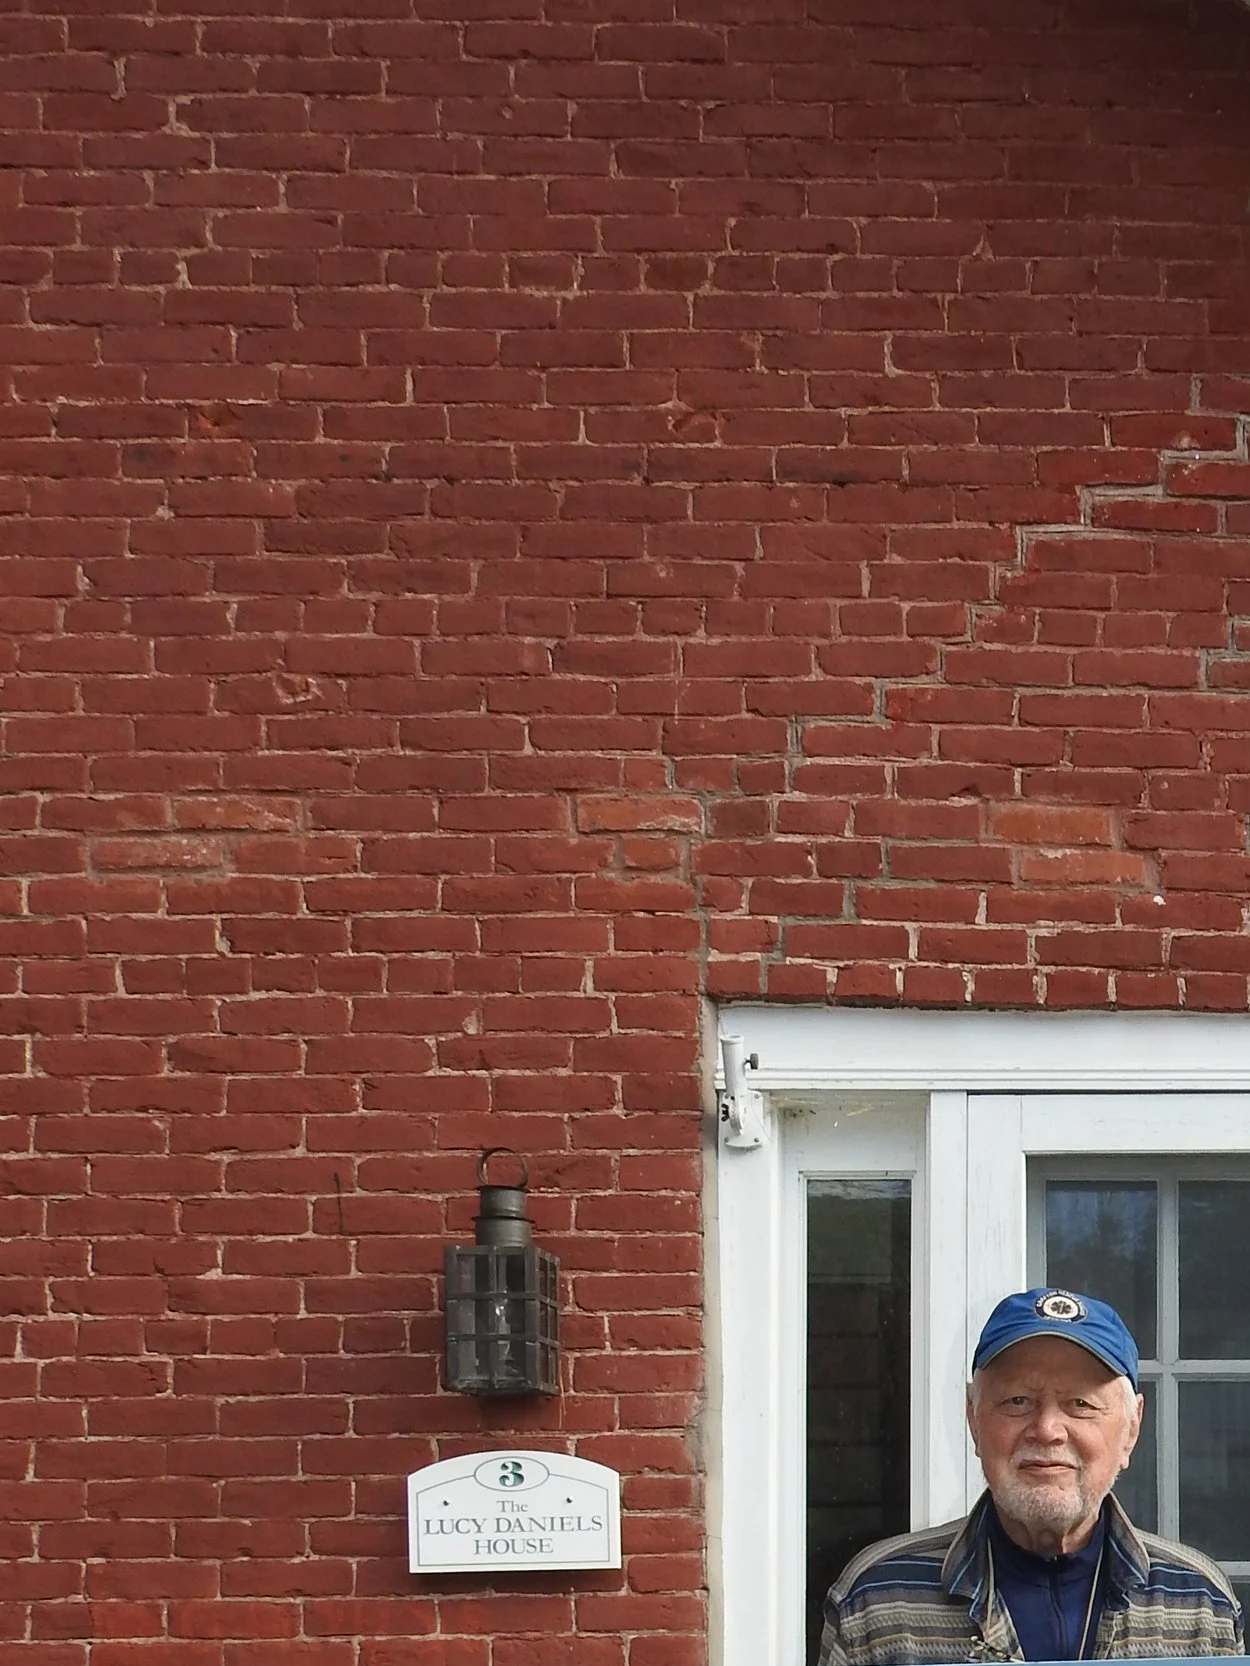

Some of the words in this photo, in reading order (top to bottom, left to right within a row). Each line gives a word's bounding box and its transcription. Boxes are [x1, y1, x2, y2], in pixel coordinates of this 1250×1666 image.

[499, 1461, 525, 1487] 3
[496, 1500, 529, 1513] The
[424, 1517, 488, 1535] LUCY
[494, 1515, 603, 1534] DANIELS
[473, 1538, 554, 1555] HOUSE
